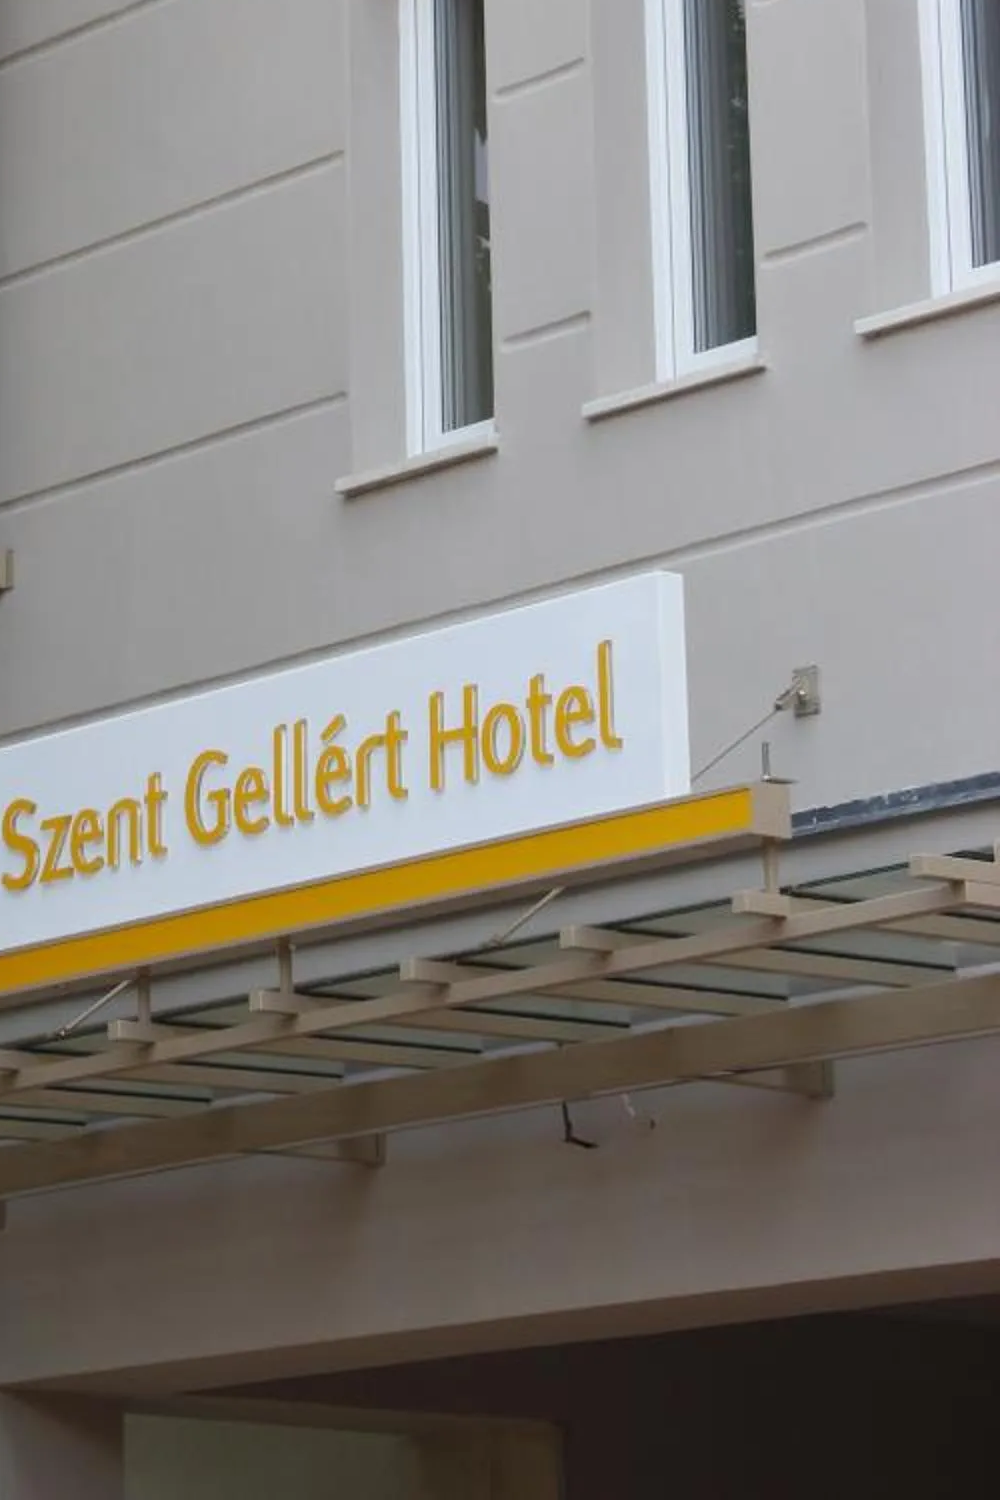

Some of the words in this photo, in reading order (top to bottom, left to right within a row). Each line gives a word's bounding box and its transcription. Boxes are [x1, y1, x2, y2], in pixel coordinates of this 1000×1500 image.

[1, 771, 168, 891] Szent
[184, 711, 408, 846] Gellért
[429, 639, 623, 792] Hotel
